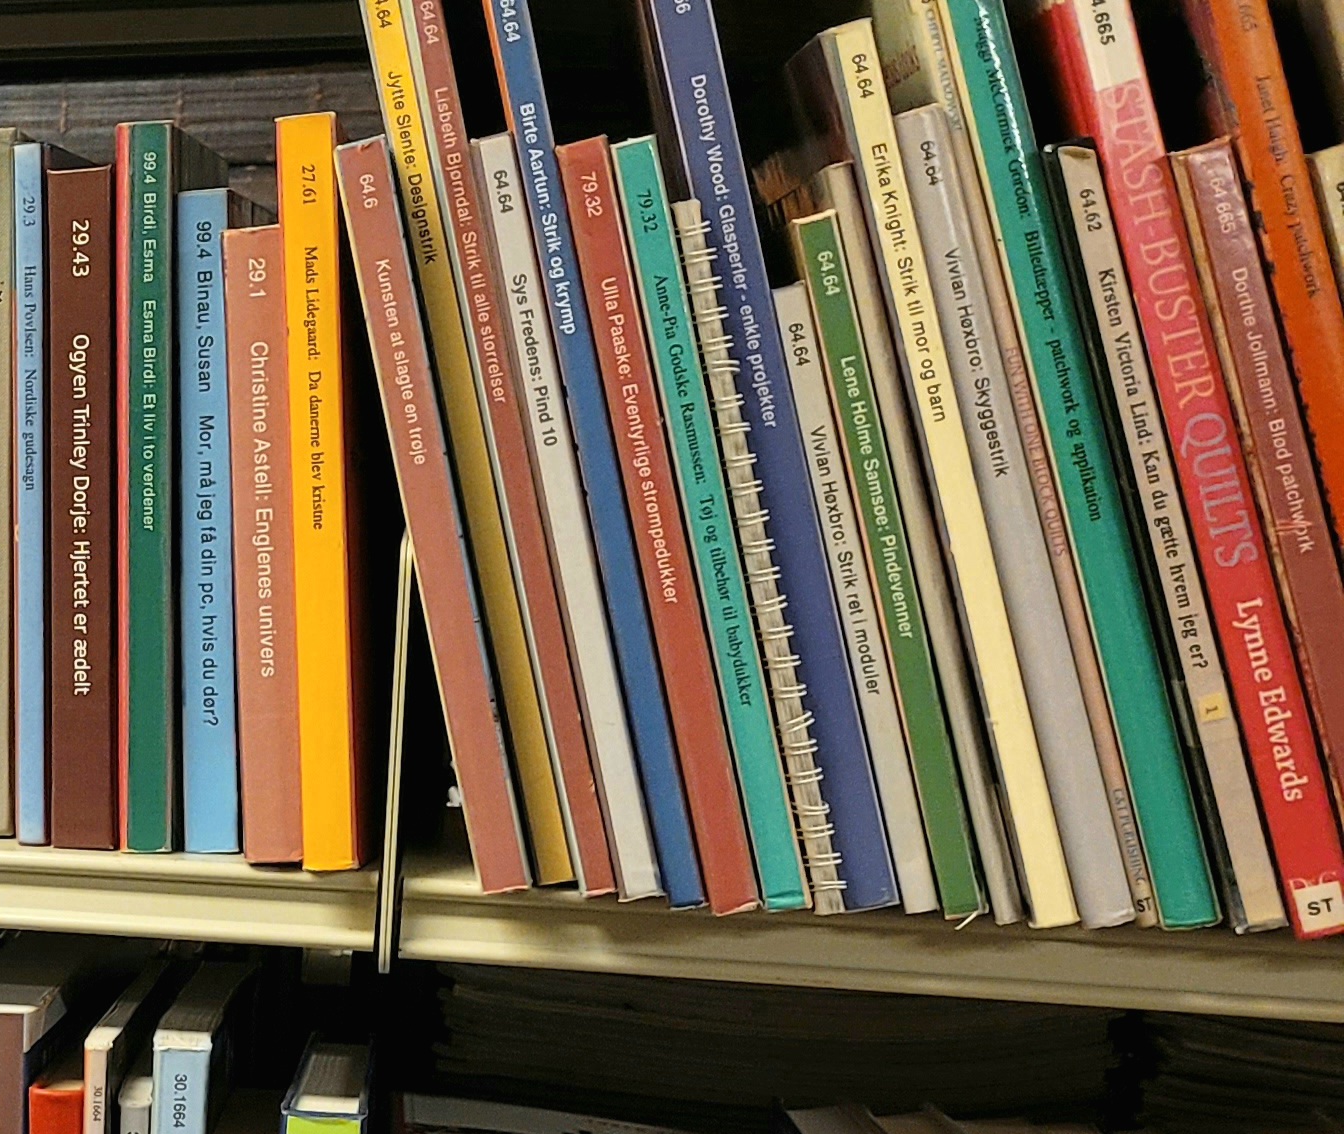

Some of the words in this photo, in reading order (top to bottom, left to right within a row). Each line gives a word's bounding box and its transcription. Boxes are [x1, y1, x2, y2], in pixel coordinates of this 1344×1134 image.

[850, 52, 875, 99] 64.64
[870, 142, 892, 188] Erika
[881, 189, 907, 252] Knight:
[71, 219, 90, 277] 29.43
[896, 255, 919, 297] Strik
[906, 299, 925, 317] til
[911, 320, 930, 353] mor
[69, 333, 90, 399] Ogyen
[918, 357, 936, 381] og
[926, 382, 946, 423] barn
[69, 403, 91, 470] Trinley
[69, 475, 91, 534] Dorje:
[1180, 411, 1259, 569] QUILTS
[69, 540, 91, 608] Hjertet
[73, 612, 87, 634] er
[73, 638, 91, 696] ædelt
[1231, 597, 1273, 683] Lynne
[1258, 685, 1309, 802] Edwards
[1307, 897, 1334, 916] ST
